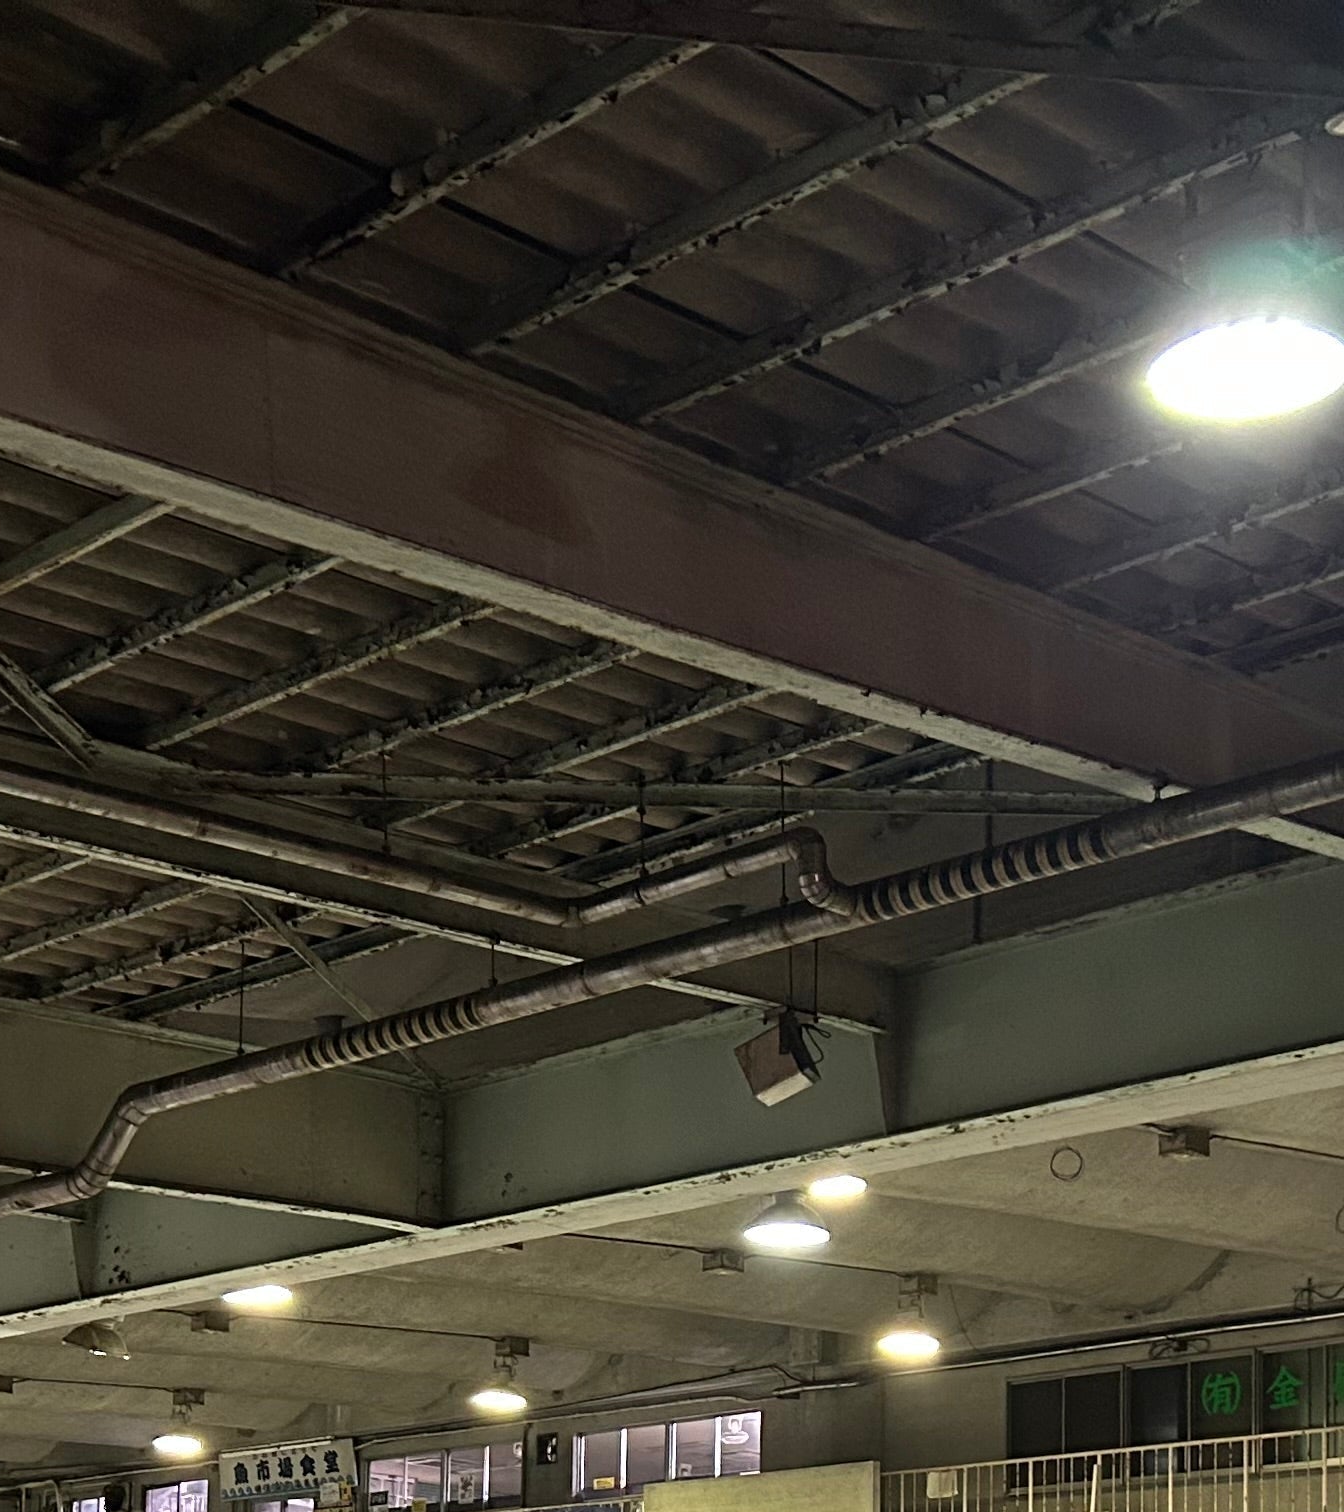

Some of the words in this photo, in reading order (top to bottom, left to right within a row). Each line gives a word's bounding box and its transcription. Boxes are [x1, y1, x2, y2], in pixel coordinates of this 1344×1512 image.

[234, 1450, 339, 1485] 魚市場食堂
